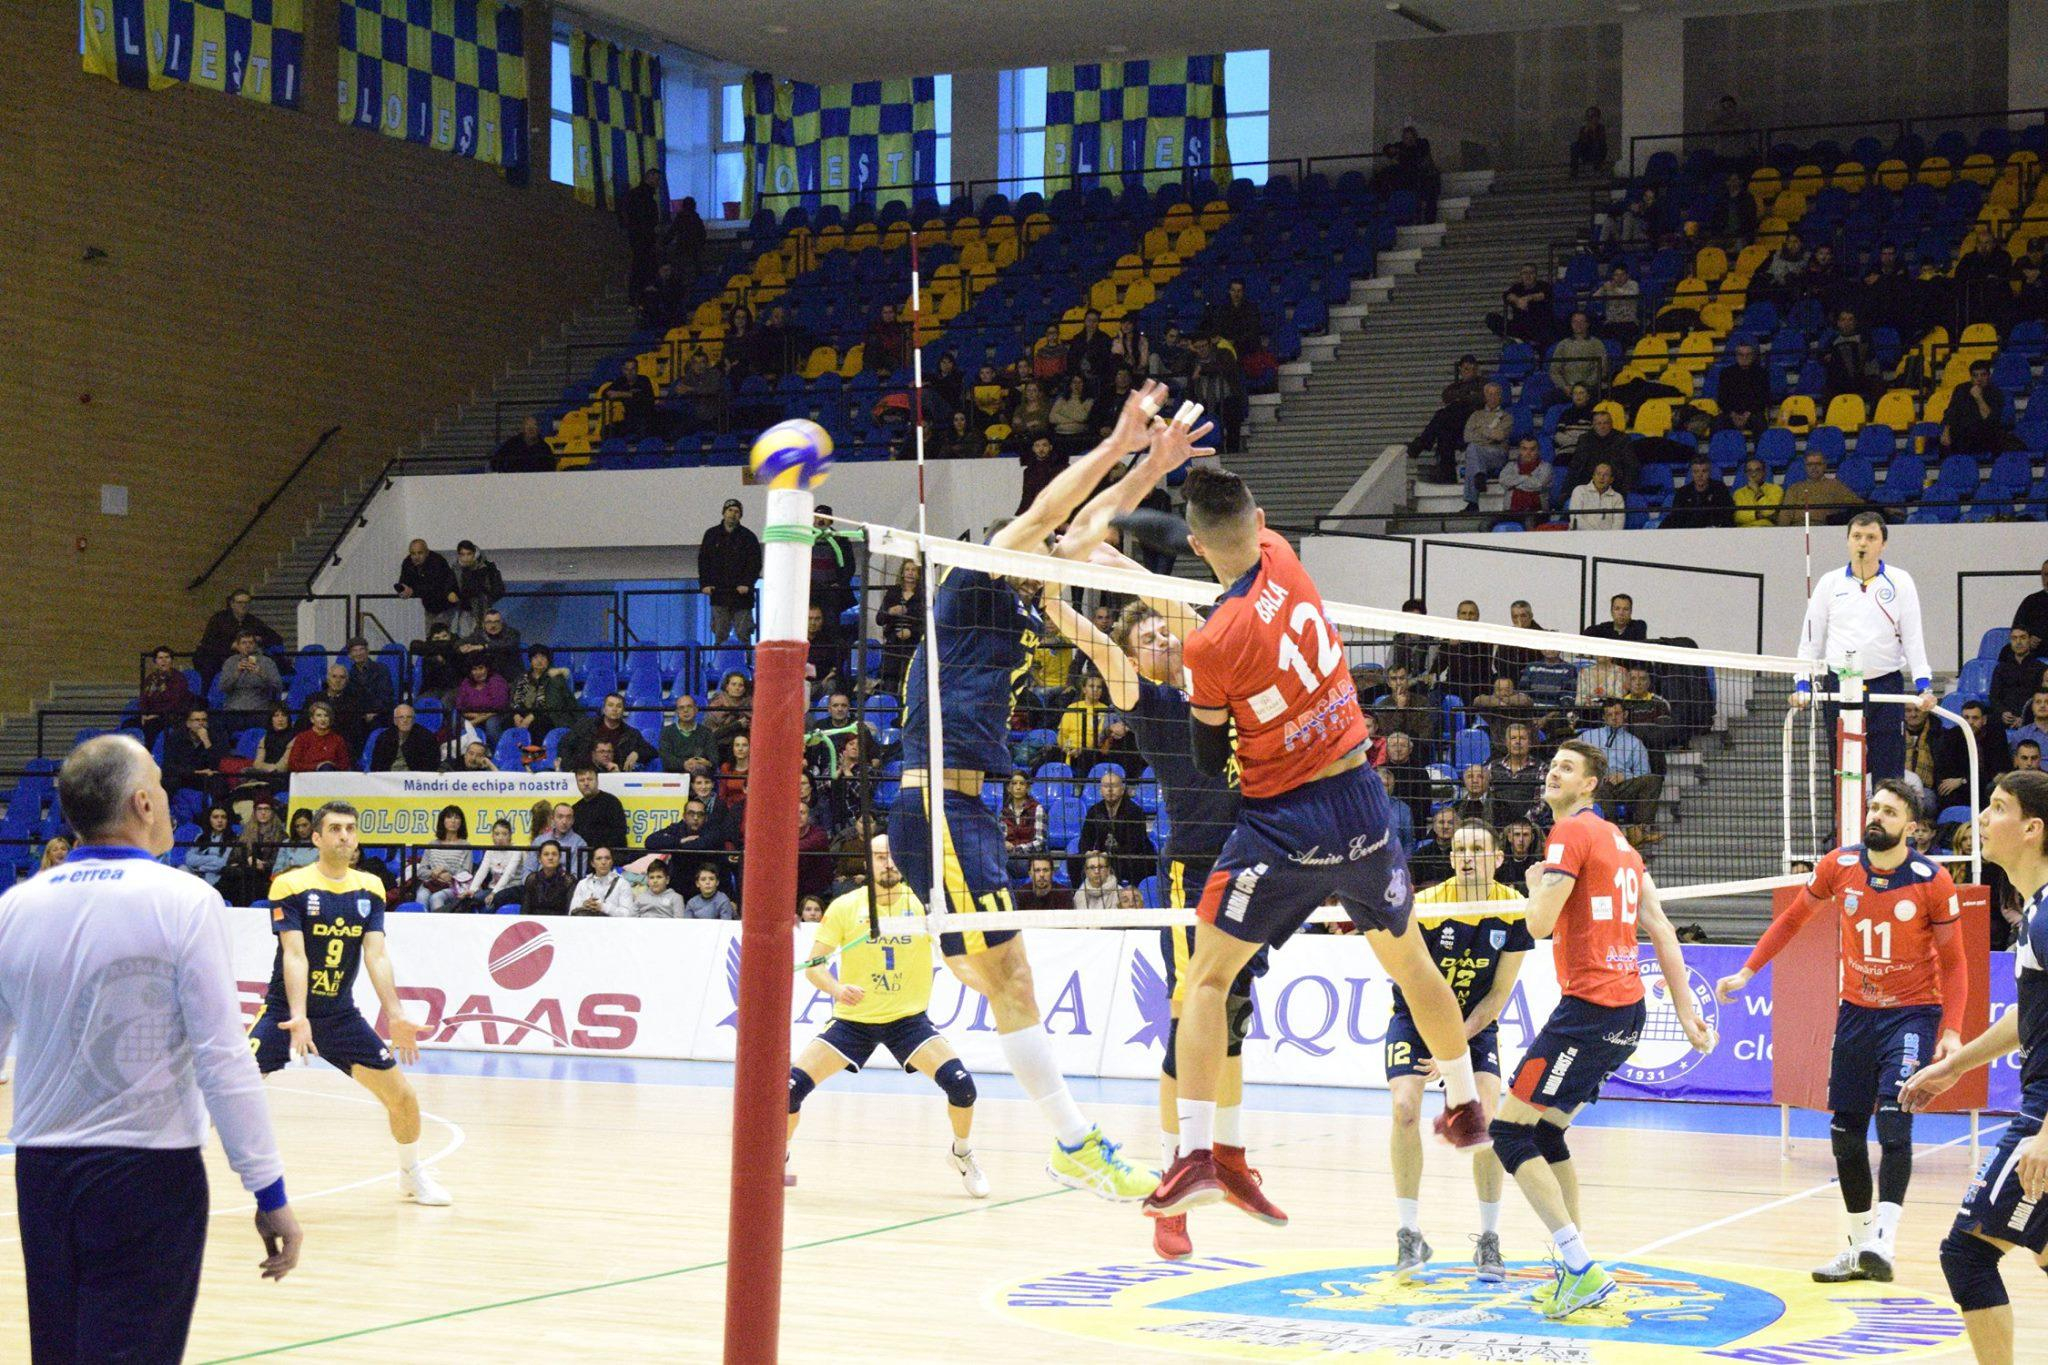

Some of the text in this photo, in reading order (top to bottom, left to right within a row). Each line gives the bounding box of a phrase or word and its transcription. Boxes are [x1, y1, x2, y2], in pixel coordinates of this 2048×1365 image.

[1254, 579, 1289, 625] BALA
[1278, 601, 1343, 695] 12
[404, 779, 448, 791] Mândri
[452, 779, 467, 791] de
[472, 780, 514, 794] echipa
[1613, 867, 1638, 925] 19
[313, 923, 363, 938] DAAS
[1855, 918, 1892, 960] 11
[325, 939, 344, 967] 9
[881, 946, 895, 971] 1
[1445, 966, 1476, 987] 12
[1387, 1041, 1411, 1069] 12
[1626, 1068, 1665, 1081] 1931
